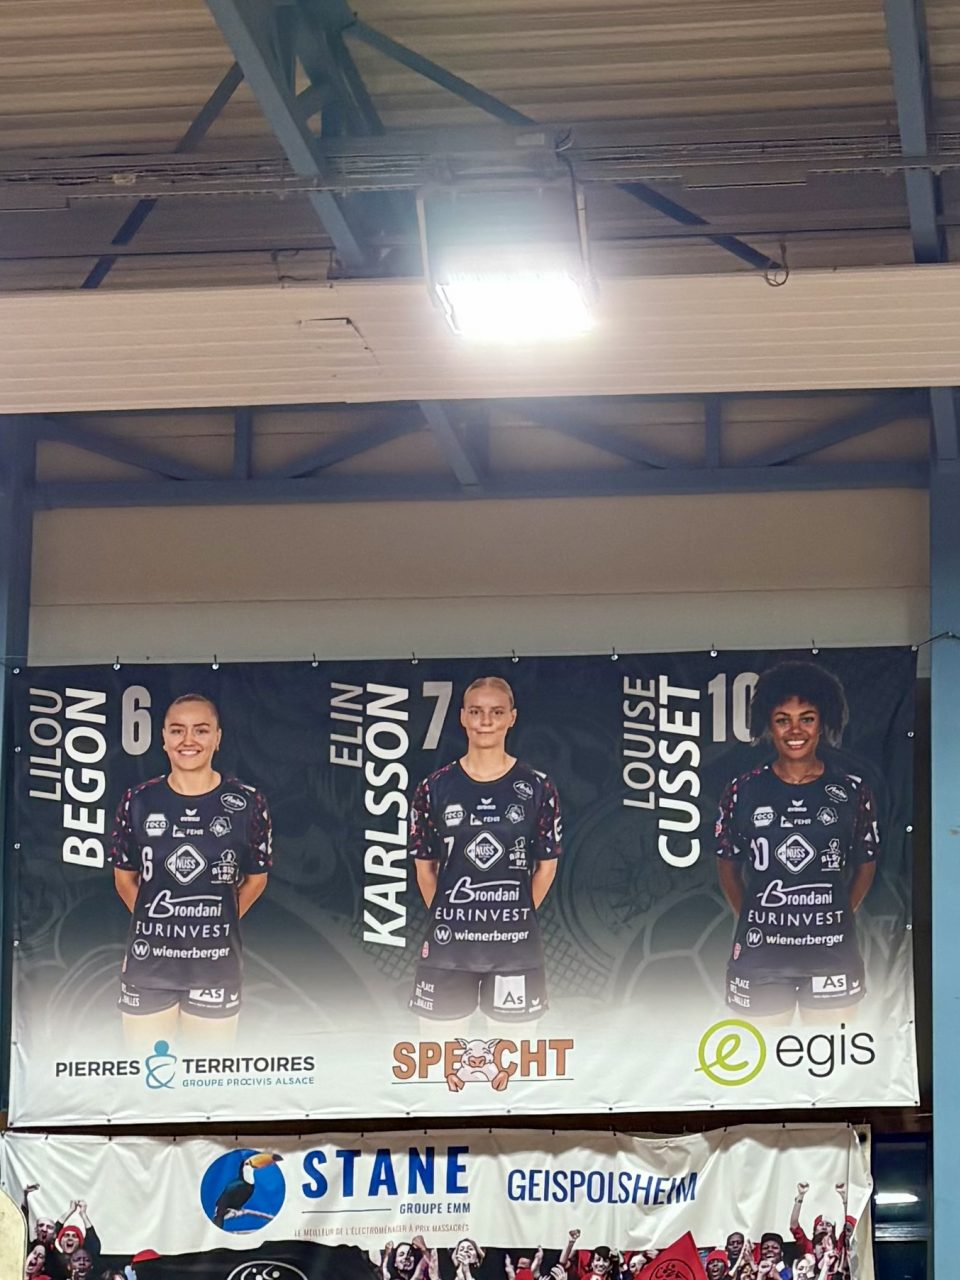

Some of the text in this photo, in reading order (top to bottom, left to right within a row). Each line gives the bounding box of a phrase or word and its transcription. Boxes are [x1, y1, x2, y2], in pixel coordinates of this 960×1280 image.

[121, 685, 152, 756] 6
[330, 682, 363, 768] ELIN
[422, 681, 453, 750] 7
[29, 687, 62, 801] LILOU
[623, 675, 656, 811] LOUISE
[63, 687, 107, 869] BEGON
[659, 674, 701, 868] CUSSET
[363, 683, 409, 947] KARLSSON
[142, 846, 153, 881] 6
[787, 848, 806, 858] NUSS
[445, 876, 520, 903] Brondani
[756, 879, 833, 907] Brondani
[145, 890, 222, 918] Brondani
[435, 907, 530, 921] EURINVEST
[748, 910, 844, 926] EURINVEST
[454, 930, 529, 943] wienerberger
[766, 934, 844, 947] wienerberger
[152, 946, 230, 960] wienerberger
[823, 977, 844, 989] As
[503, 992, 523, 1005] As
[776, 1023, 876, 1078] egis
[55, 1060, 141, 1078] PIERRES
[182, 1056, 315, 1074] TERRITOIRES
[182, 1076, 315, 1088] GROUPE PROCIVIS ALSACE
[302, 1146, 469, 1199] STANE
[508, 1169, 698, 1205] GEISPOLSHEIM
[400, 1203, 471, 1215] GROUPE EMM
